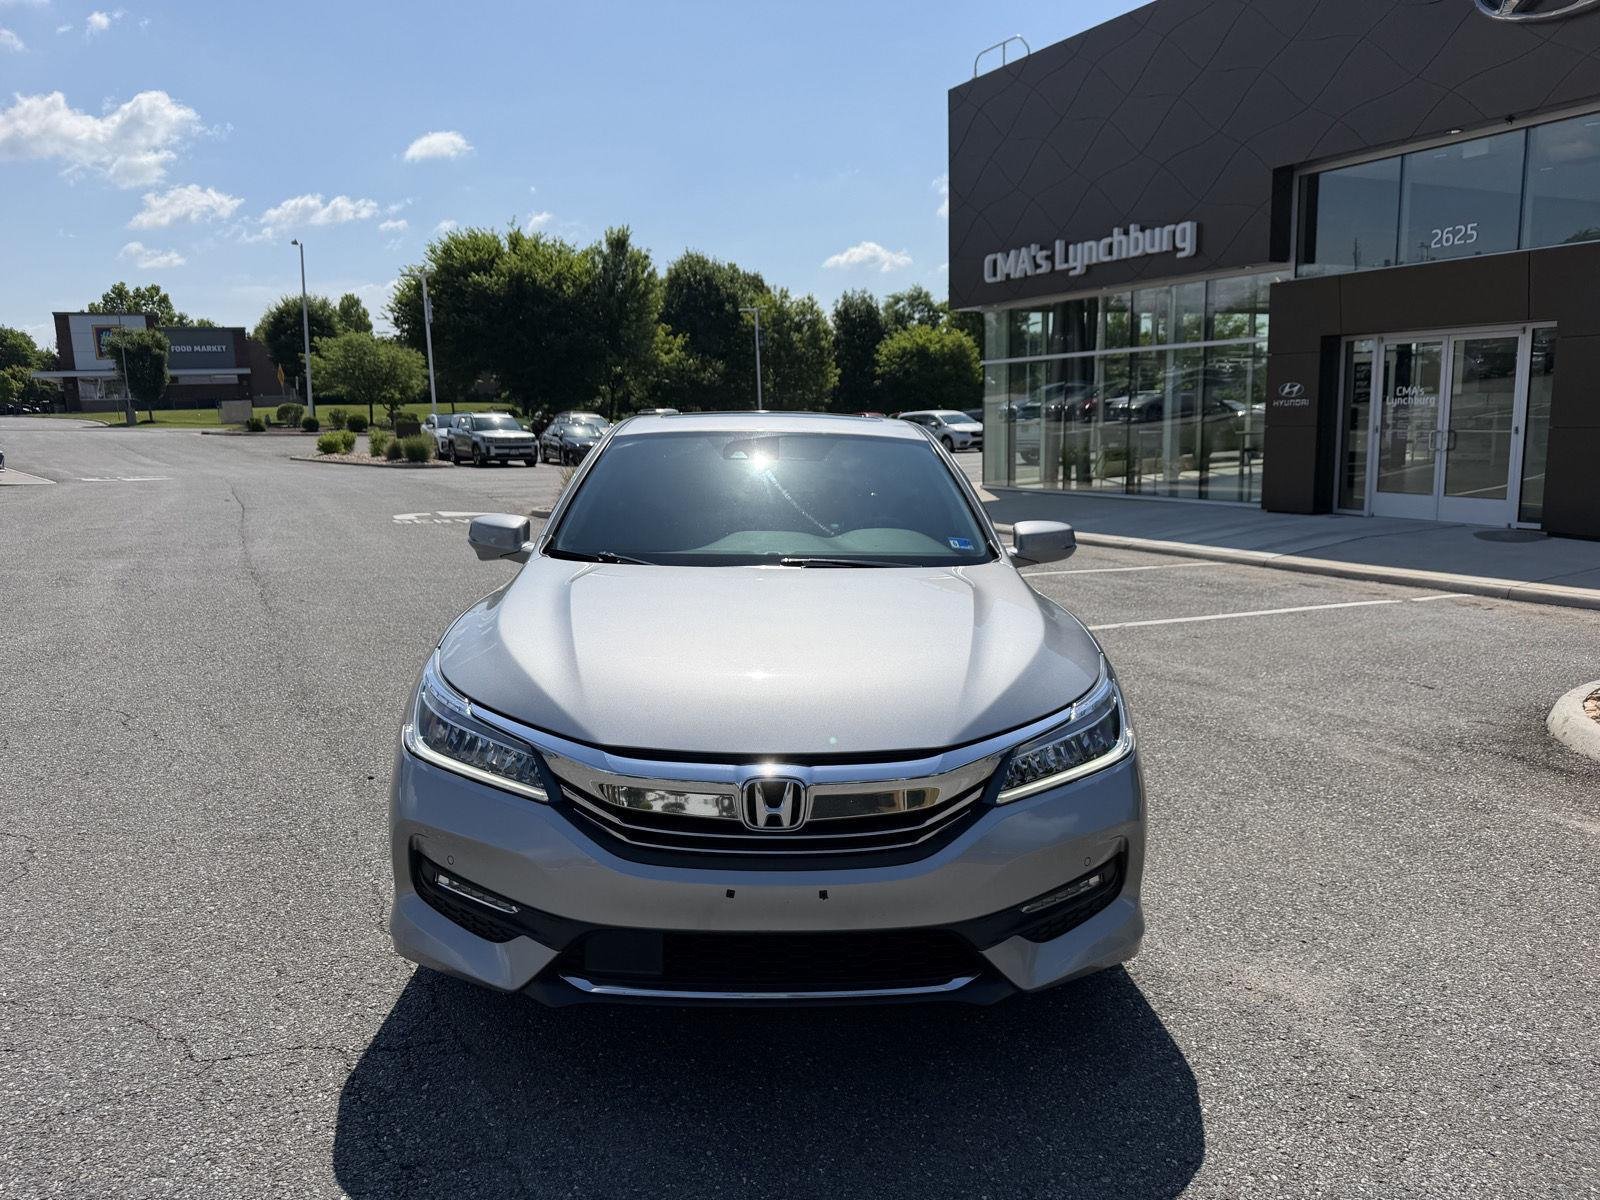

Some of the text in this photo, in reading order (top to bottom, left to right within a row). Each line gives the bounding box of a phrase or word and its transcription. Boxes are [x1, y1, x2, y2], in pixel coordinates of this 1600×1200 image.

[1431, 222, 1478, 249] 2625
[984, 221, 1198, 283] CMA's Lynchburg
[170, 344, 227, 353] FOOD MARKET
[1396, 386, 1425, 397] CMA's
[1272, 399, 1310, 408] HYUNDAI
[1386, 396, 1436, 408] Lynchburg
